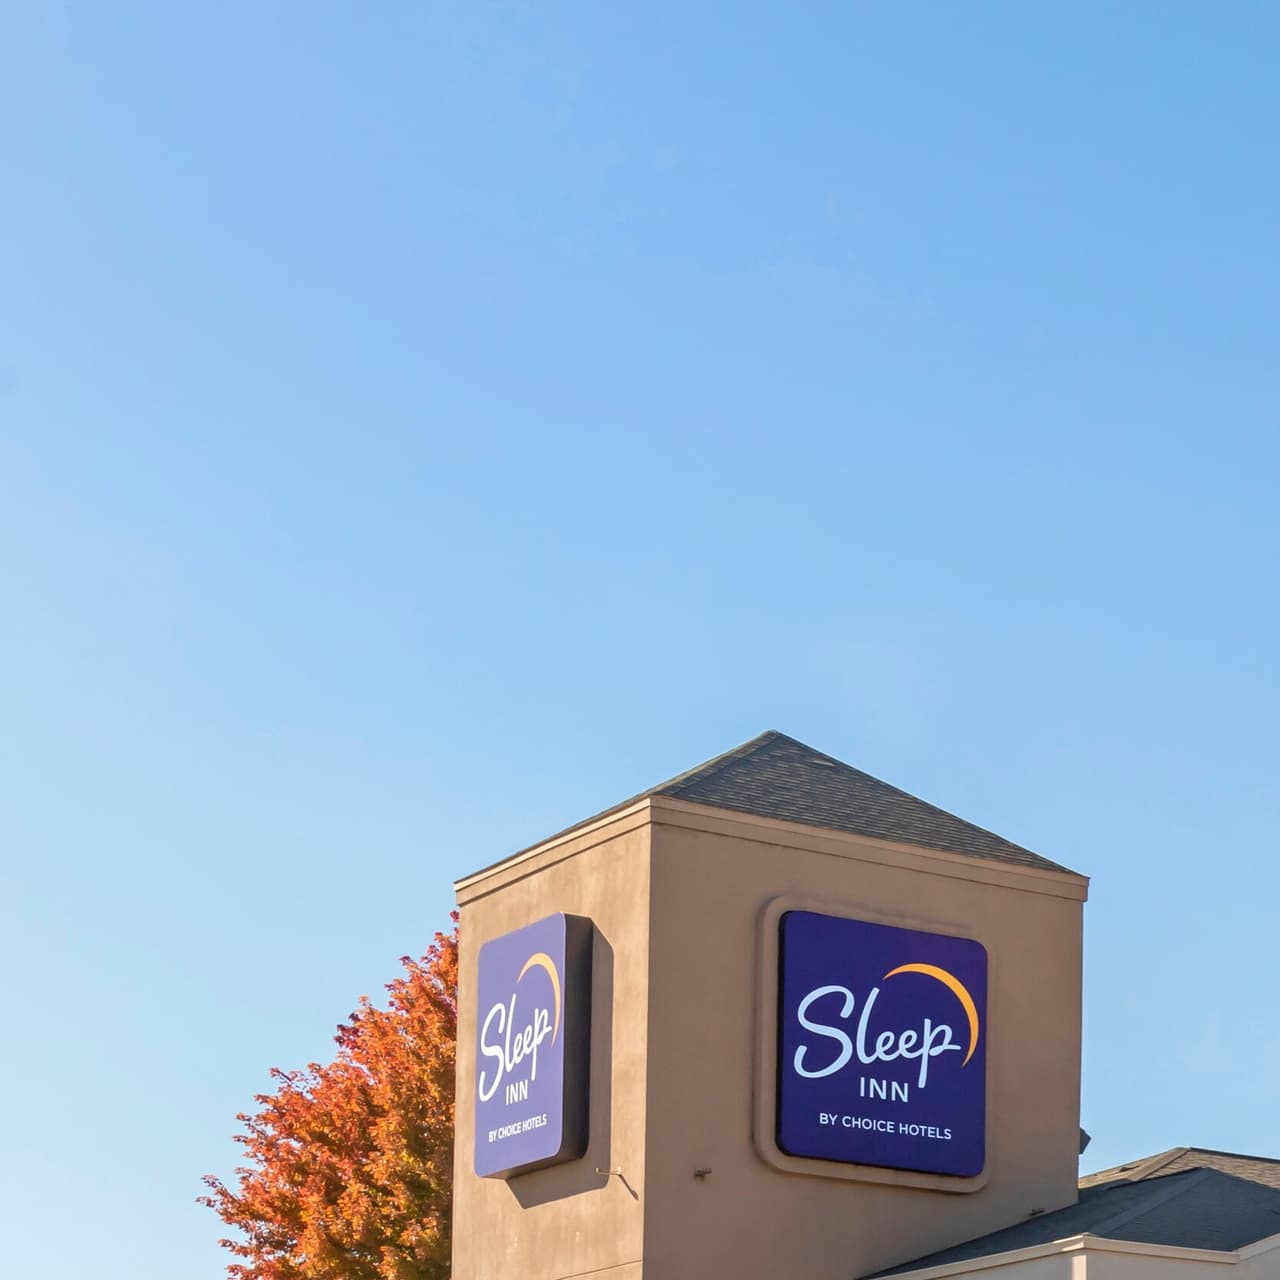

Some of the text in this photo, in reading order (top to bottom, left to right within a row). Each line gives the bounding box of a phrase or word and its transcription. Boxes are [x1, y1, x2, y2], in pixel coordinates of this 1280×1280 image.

[478, 993, 552, 1102] Sleep
[794, 985, 961, 1089] Sleep
[506, 1079, 529, 1106] INN
[860, 1077, 909, 1103] INN
[488, 1113, 547, 1143] BY CHOICE HOTELS
[819, 1112, 952, 1140] BY CHOICE HOTELS
